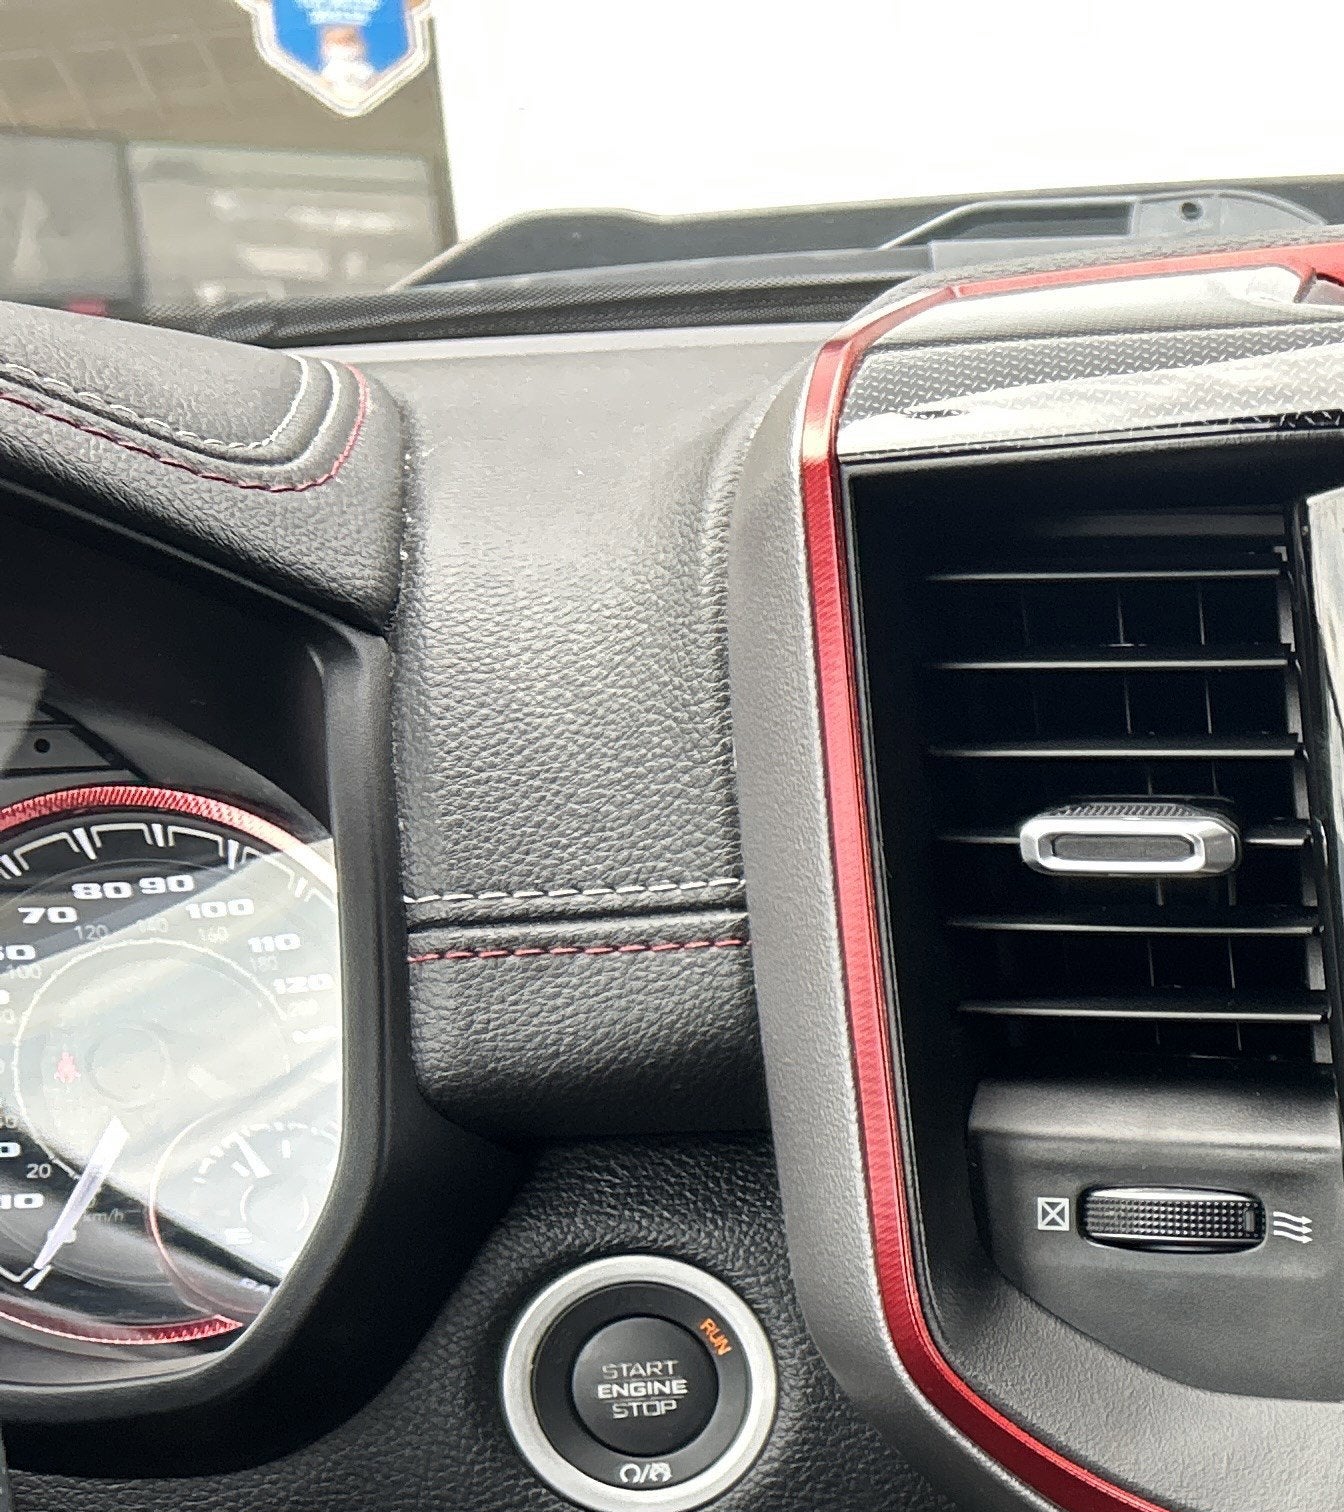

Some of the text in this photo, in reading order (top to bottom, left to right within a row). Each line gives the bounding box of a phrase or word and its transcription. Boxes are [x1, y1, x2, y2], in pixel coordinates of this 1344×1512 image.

[72, 881, 133, 900] 80
[139, 875, 195, 894] 90
[18, 906, 78, 924] 70
[186, 899, 254, 919] 100
[74, 924, 110, 942] 120
[248, 933, 301, 953] 110
[26, 1163, 52, 1179] 20
[700, 1318, 731, 1356] RUN
[601, 1359, 679, 1379] START
[597, 1379, 688, 1399] ENGINE
[611, 1400, 677, 1419] STOP
